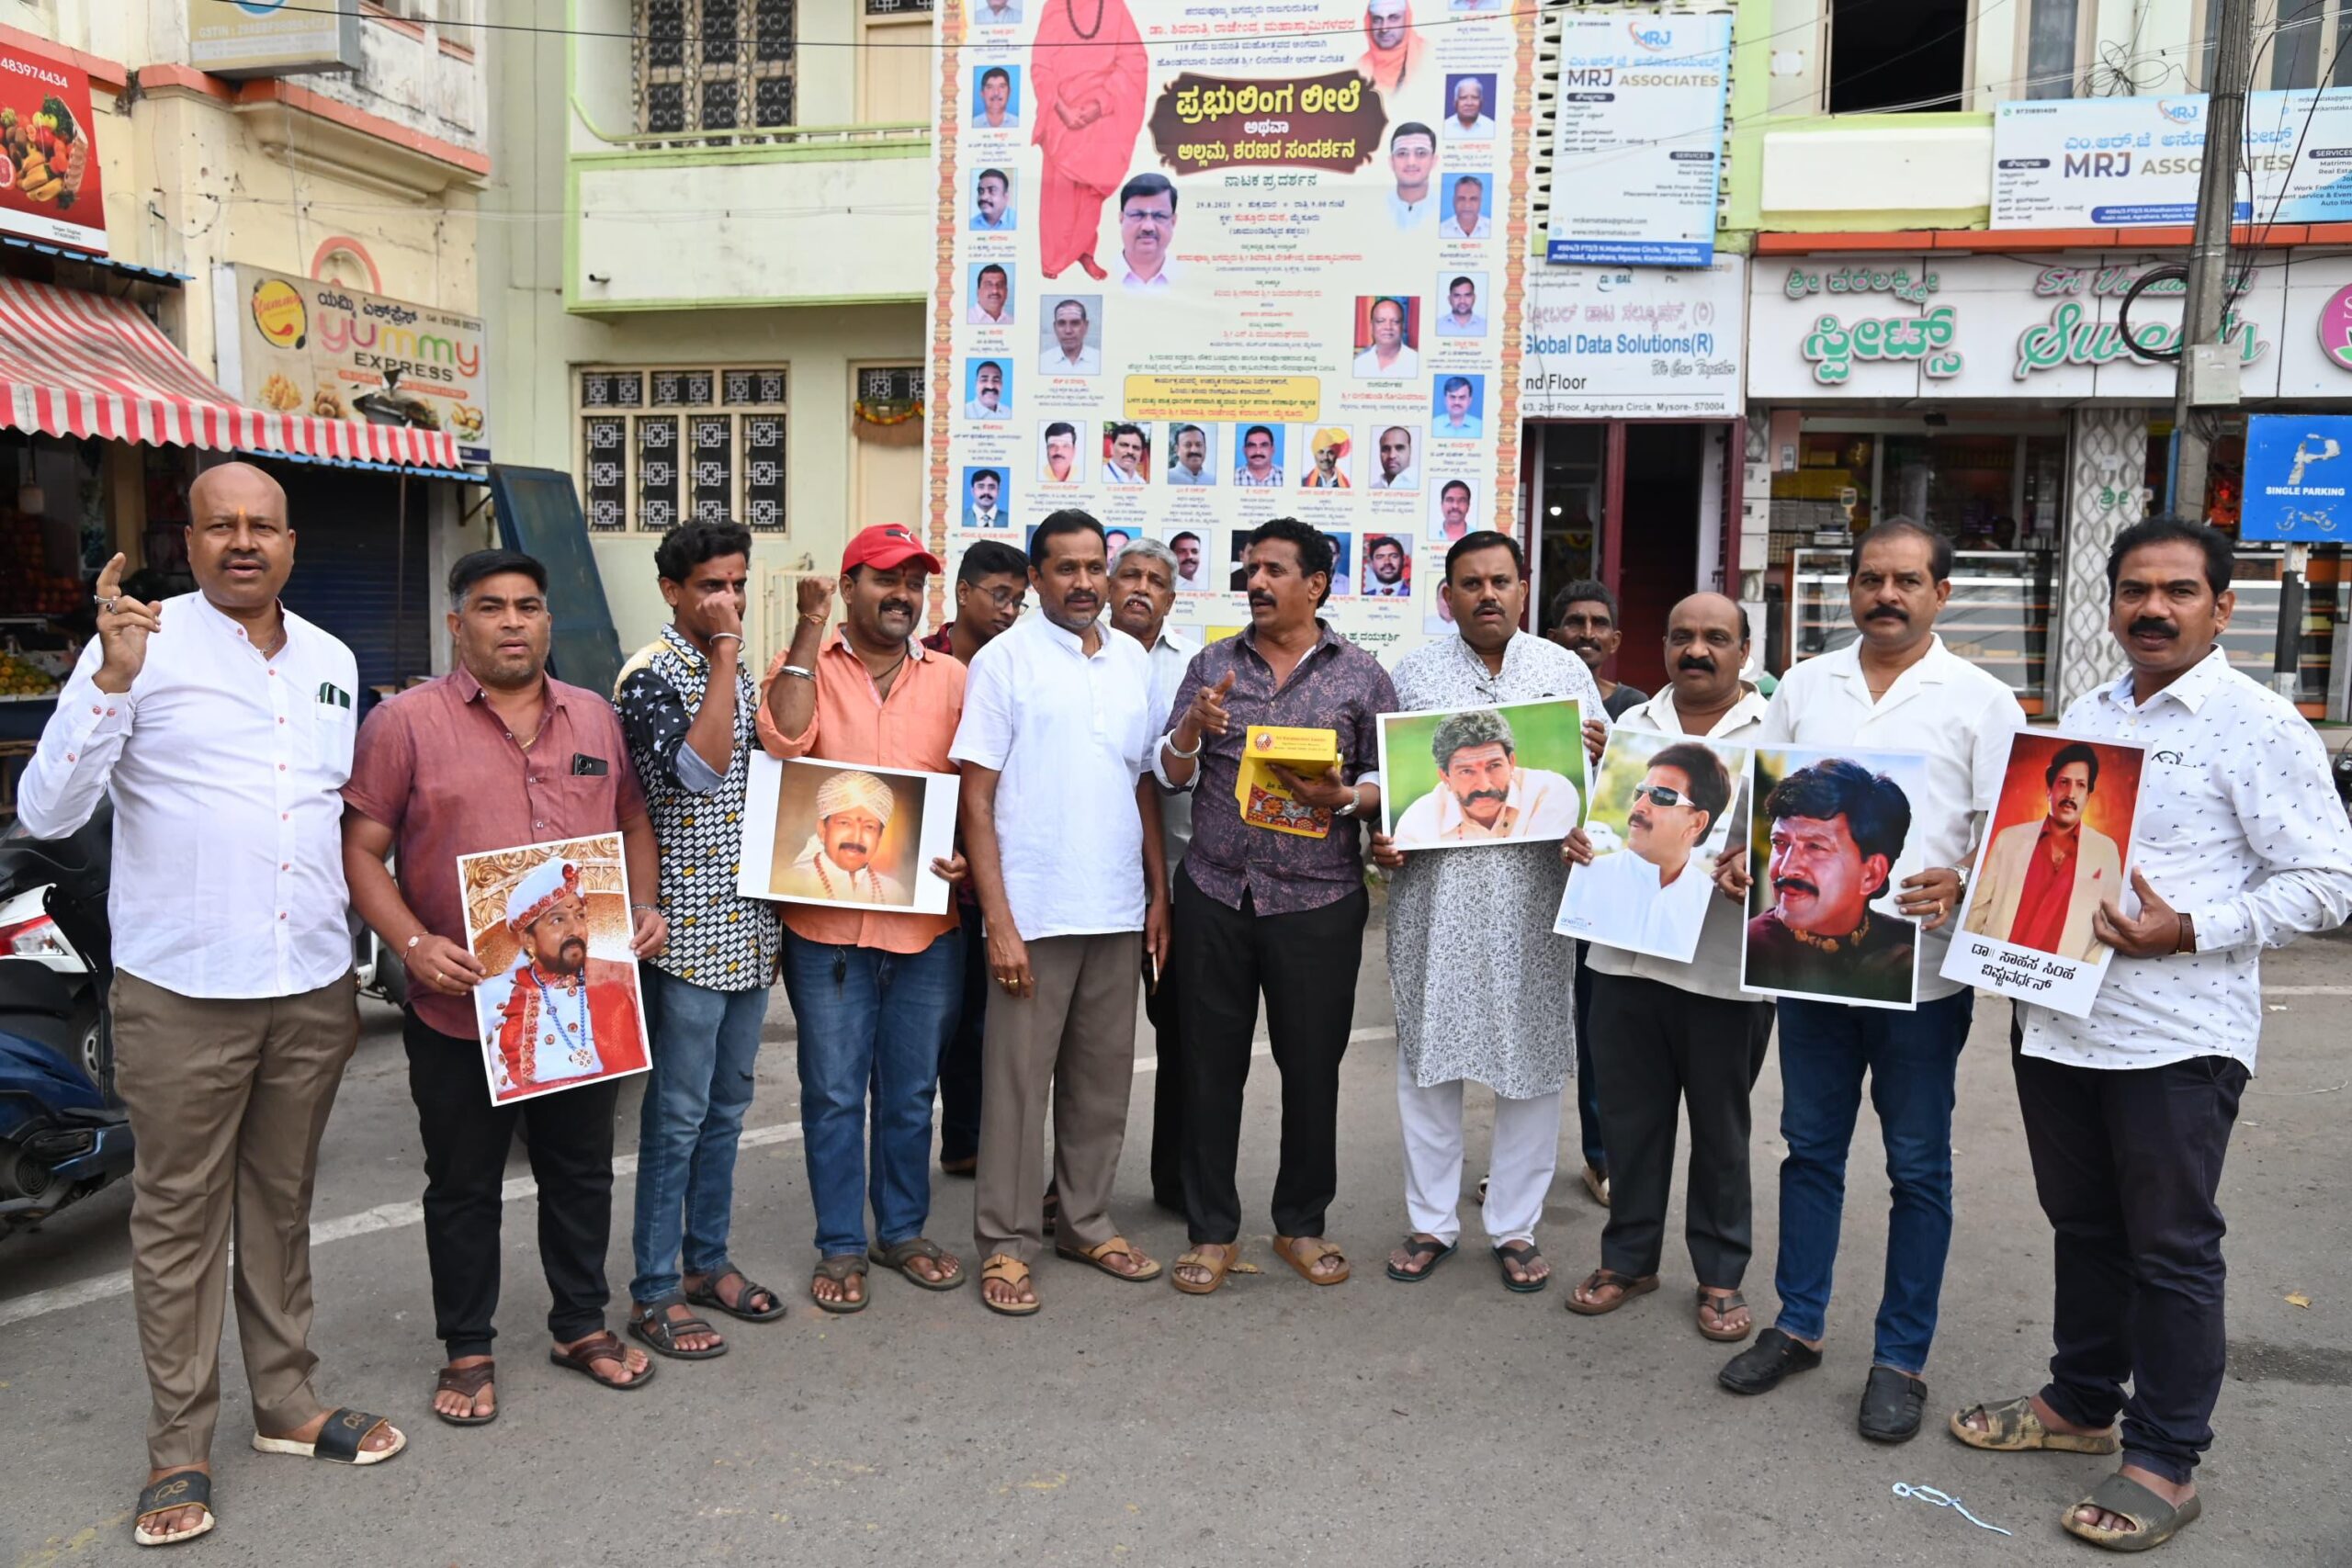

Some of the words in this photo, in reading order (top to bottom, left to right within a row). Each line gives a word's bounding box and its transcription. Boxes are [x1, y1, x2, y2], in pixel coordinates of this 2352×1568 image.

[1567, 69, 1613, 86] MRJ
[1618, 74, 1720, 87] ASSOCIATES
[1176, 84, 1294, 123] ಪ್ರಭುಲಿಂಗ
[1300, 80, 1362, 114] ಲೀಲೆ
[2165, 106, 2199, 120] MRJ
[1244, 118, 1289, 137] ಅಥವಾ
[1234, 141, 1282, 160] ಶರಣರ
[1285, 139, 1355, 159] ಸಂದರ್ಶನ
[2064, 152, 2131, 178] MRJ
[2141, 154, 2291, 175] ASSOTES
[1225, 175, 1260, 186] ನಾಟಕ
[1263, 174, 1317, 191] ಪ್ರದರ್ಶನ
[1786, 267, 1820, 299] ಶ್ರೀ
[2037, 267, 2082, 296] Sri
[319, 312, 481, 378] yummy
[1577, 334, 1612, 355] Data
[1616, 333, 1714, 357] Solutions(R)
[355, 352, 454, 382] EXPRESS
[1548, 373, 1587, 389] Floor
[1539, 402, 1555, 412] 2nd
[1556, 402, 1580, 413] Floor,
[1583, 402, 1624, 414] Agrahara
[1693, 401, 1725, 412] 570004
[2100, 485, 2129, 511] ಶ್ರೀ
[2266, 486, 2301, 496] SINGLE
[2302, 486, 2345, 497] PARKING
[1999, 950, 2040, 970] ಸಾಹಸ
[2041, 962, 2076, 980] ಸಿಂಹ
